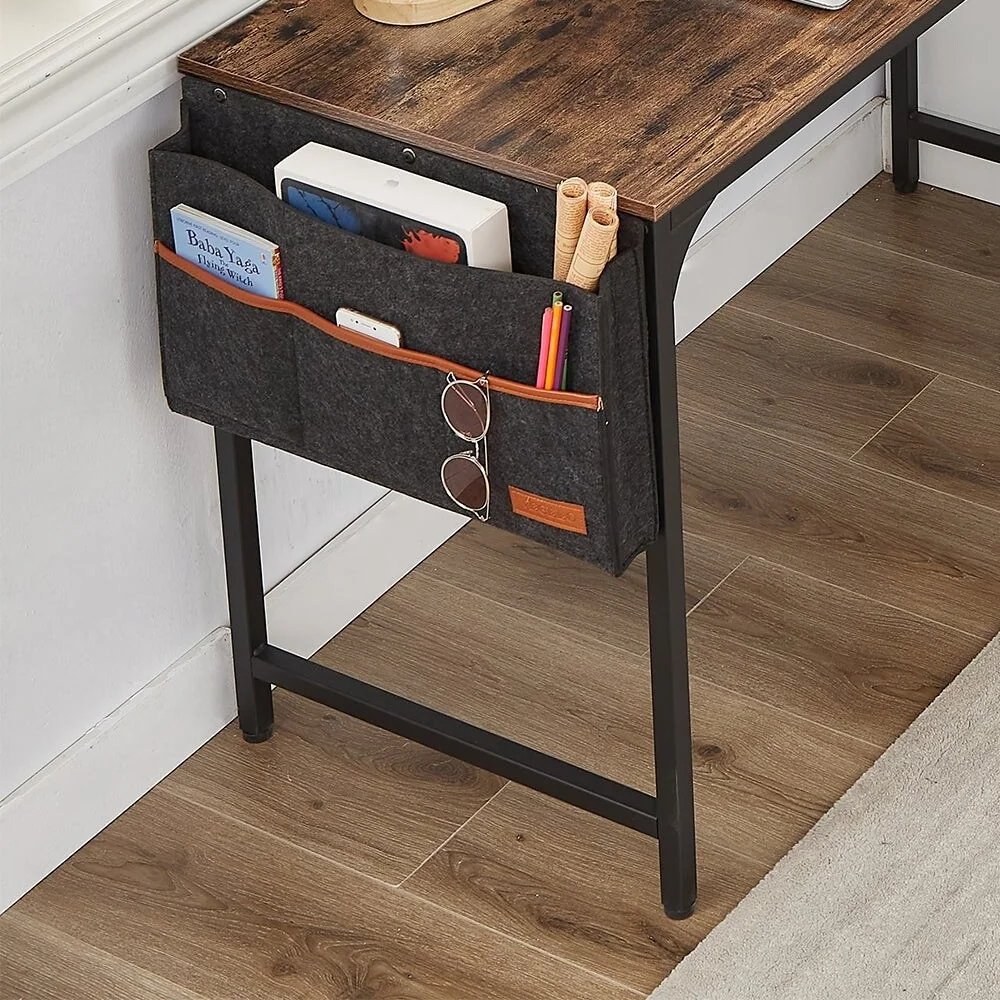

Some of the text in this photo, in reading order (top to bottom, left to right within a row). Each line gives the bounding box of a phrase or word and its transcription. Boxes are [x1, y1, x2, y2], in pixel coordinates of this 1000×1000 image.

[186, 228, 224, 259] Baba
[223, 246, 261, 275] Yaga
[226, 268, 254, 288] Witch
